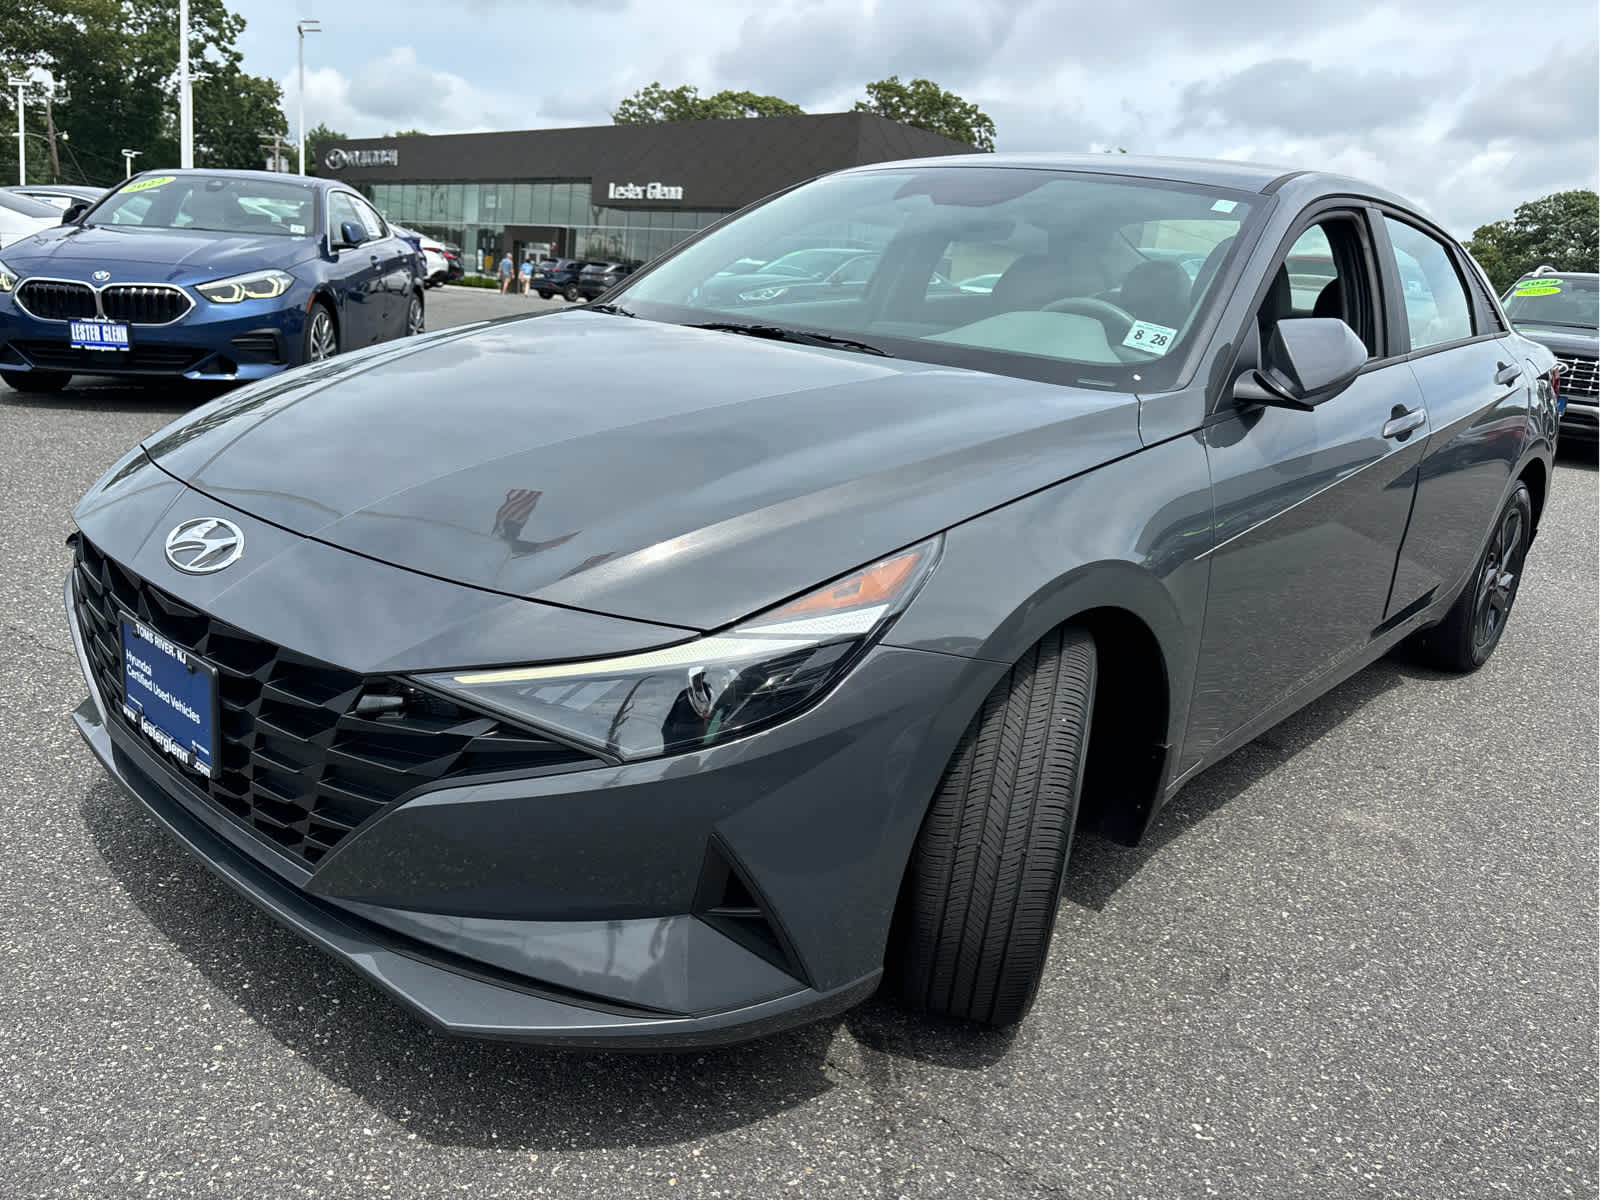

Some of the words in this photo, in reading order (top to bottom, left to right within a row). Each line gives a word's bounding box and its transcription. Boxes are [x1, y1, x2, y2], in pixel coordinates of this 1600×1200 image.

[608, 182, 646, 200] Lester
[71, 323, 101, 341] LESTER
[102, 325, 128, 342] GLENN
[1134, 329, 1145, 340] 8
[1149, 333, 1168, 346] 28
[135, 623, 154, 645] TOMS
[176, 649, 187, 665] NJ
[125, 648, 152, 677] Hyundai
[126, 663, 153, 692] Certified
[152, 682, 170, 705] Used
[170, 694, 201, 725] Vehicles
